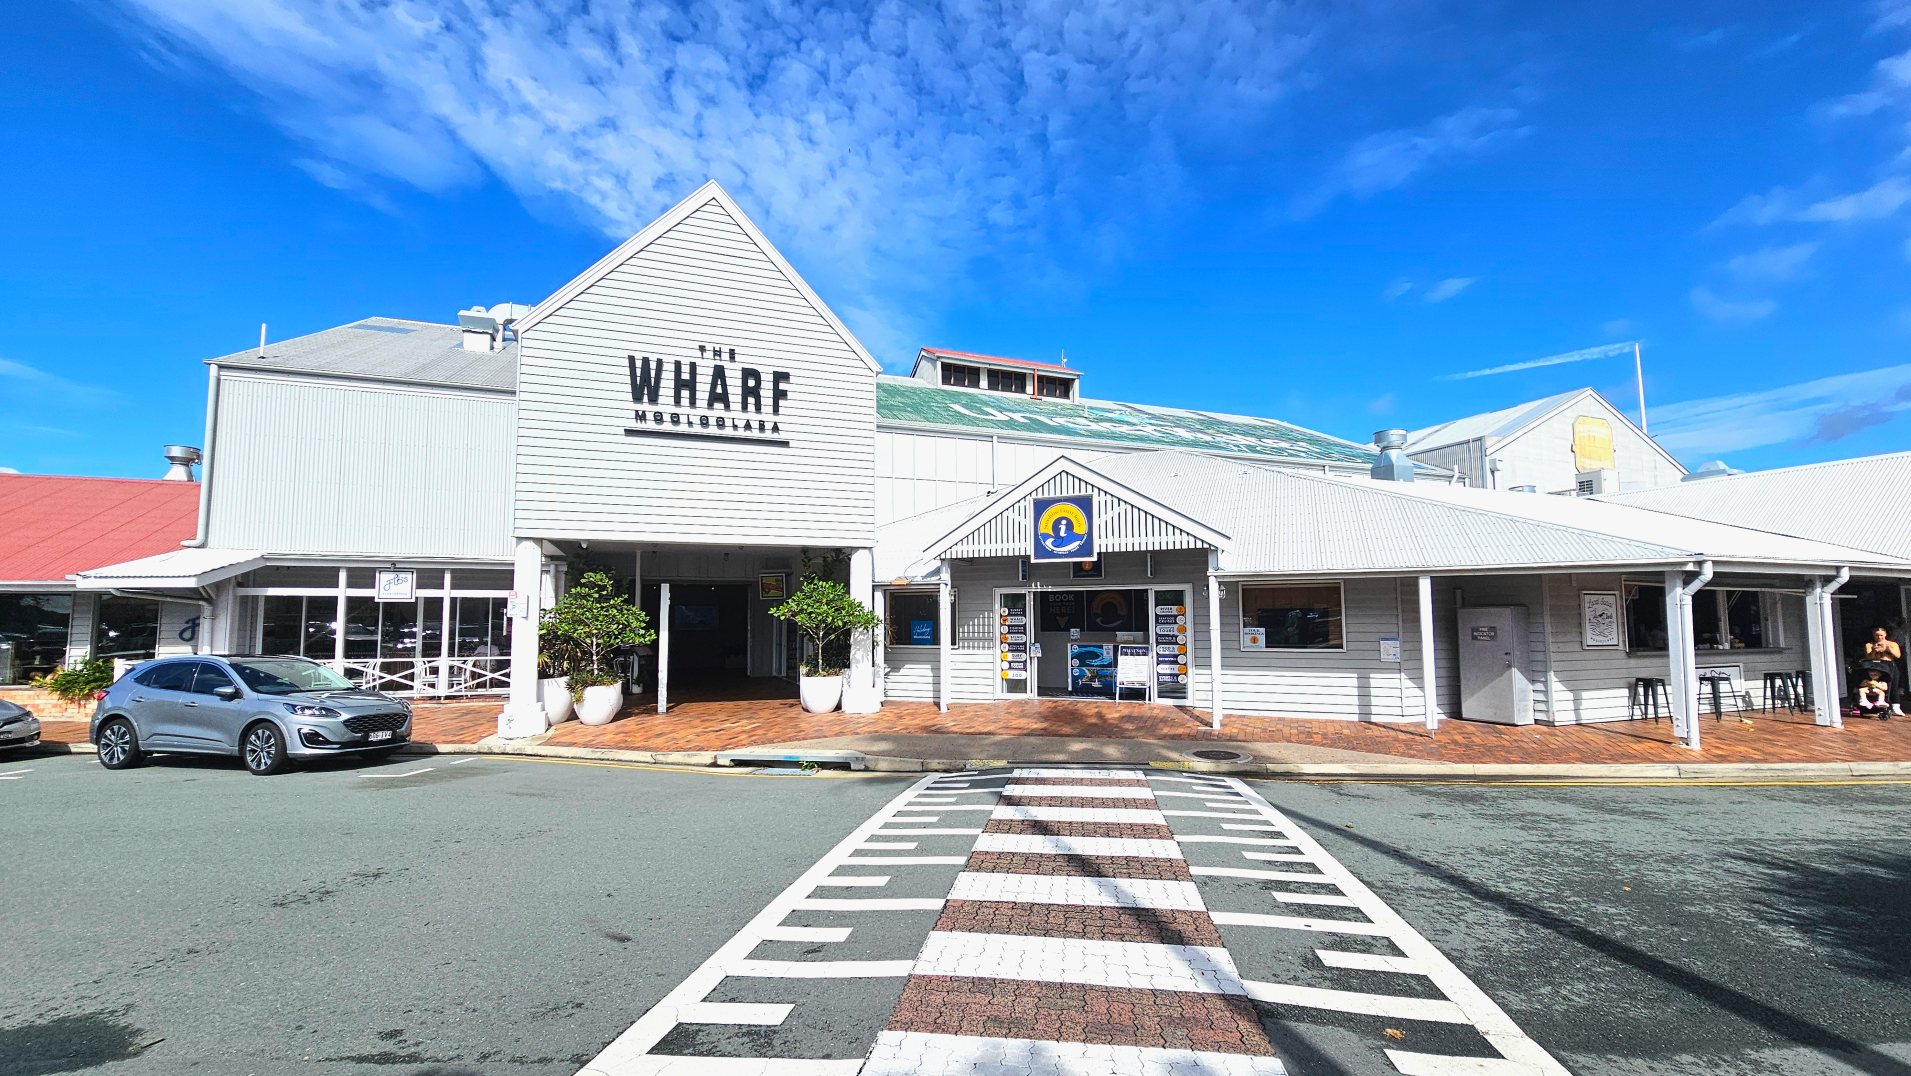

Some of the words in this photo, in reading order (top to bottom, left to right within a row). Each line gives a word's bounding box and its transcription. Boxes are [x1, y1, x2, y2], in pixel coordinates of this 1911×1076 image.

[698, 345, 736, 362] THE
[628, 355, 790, 416] WHARF
[635, 410, 781, 435] MOOLOOLABA
[1048, 594, 1075, 602] BOOK
